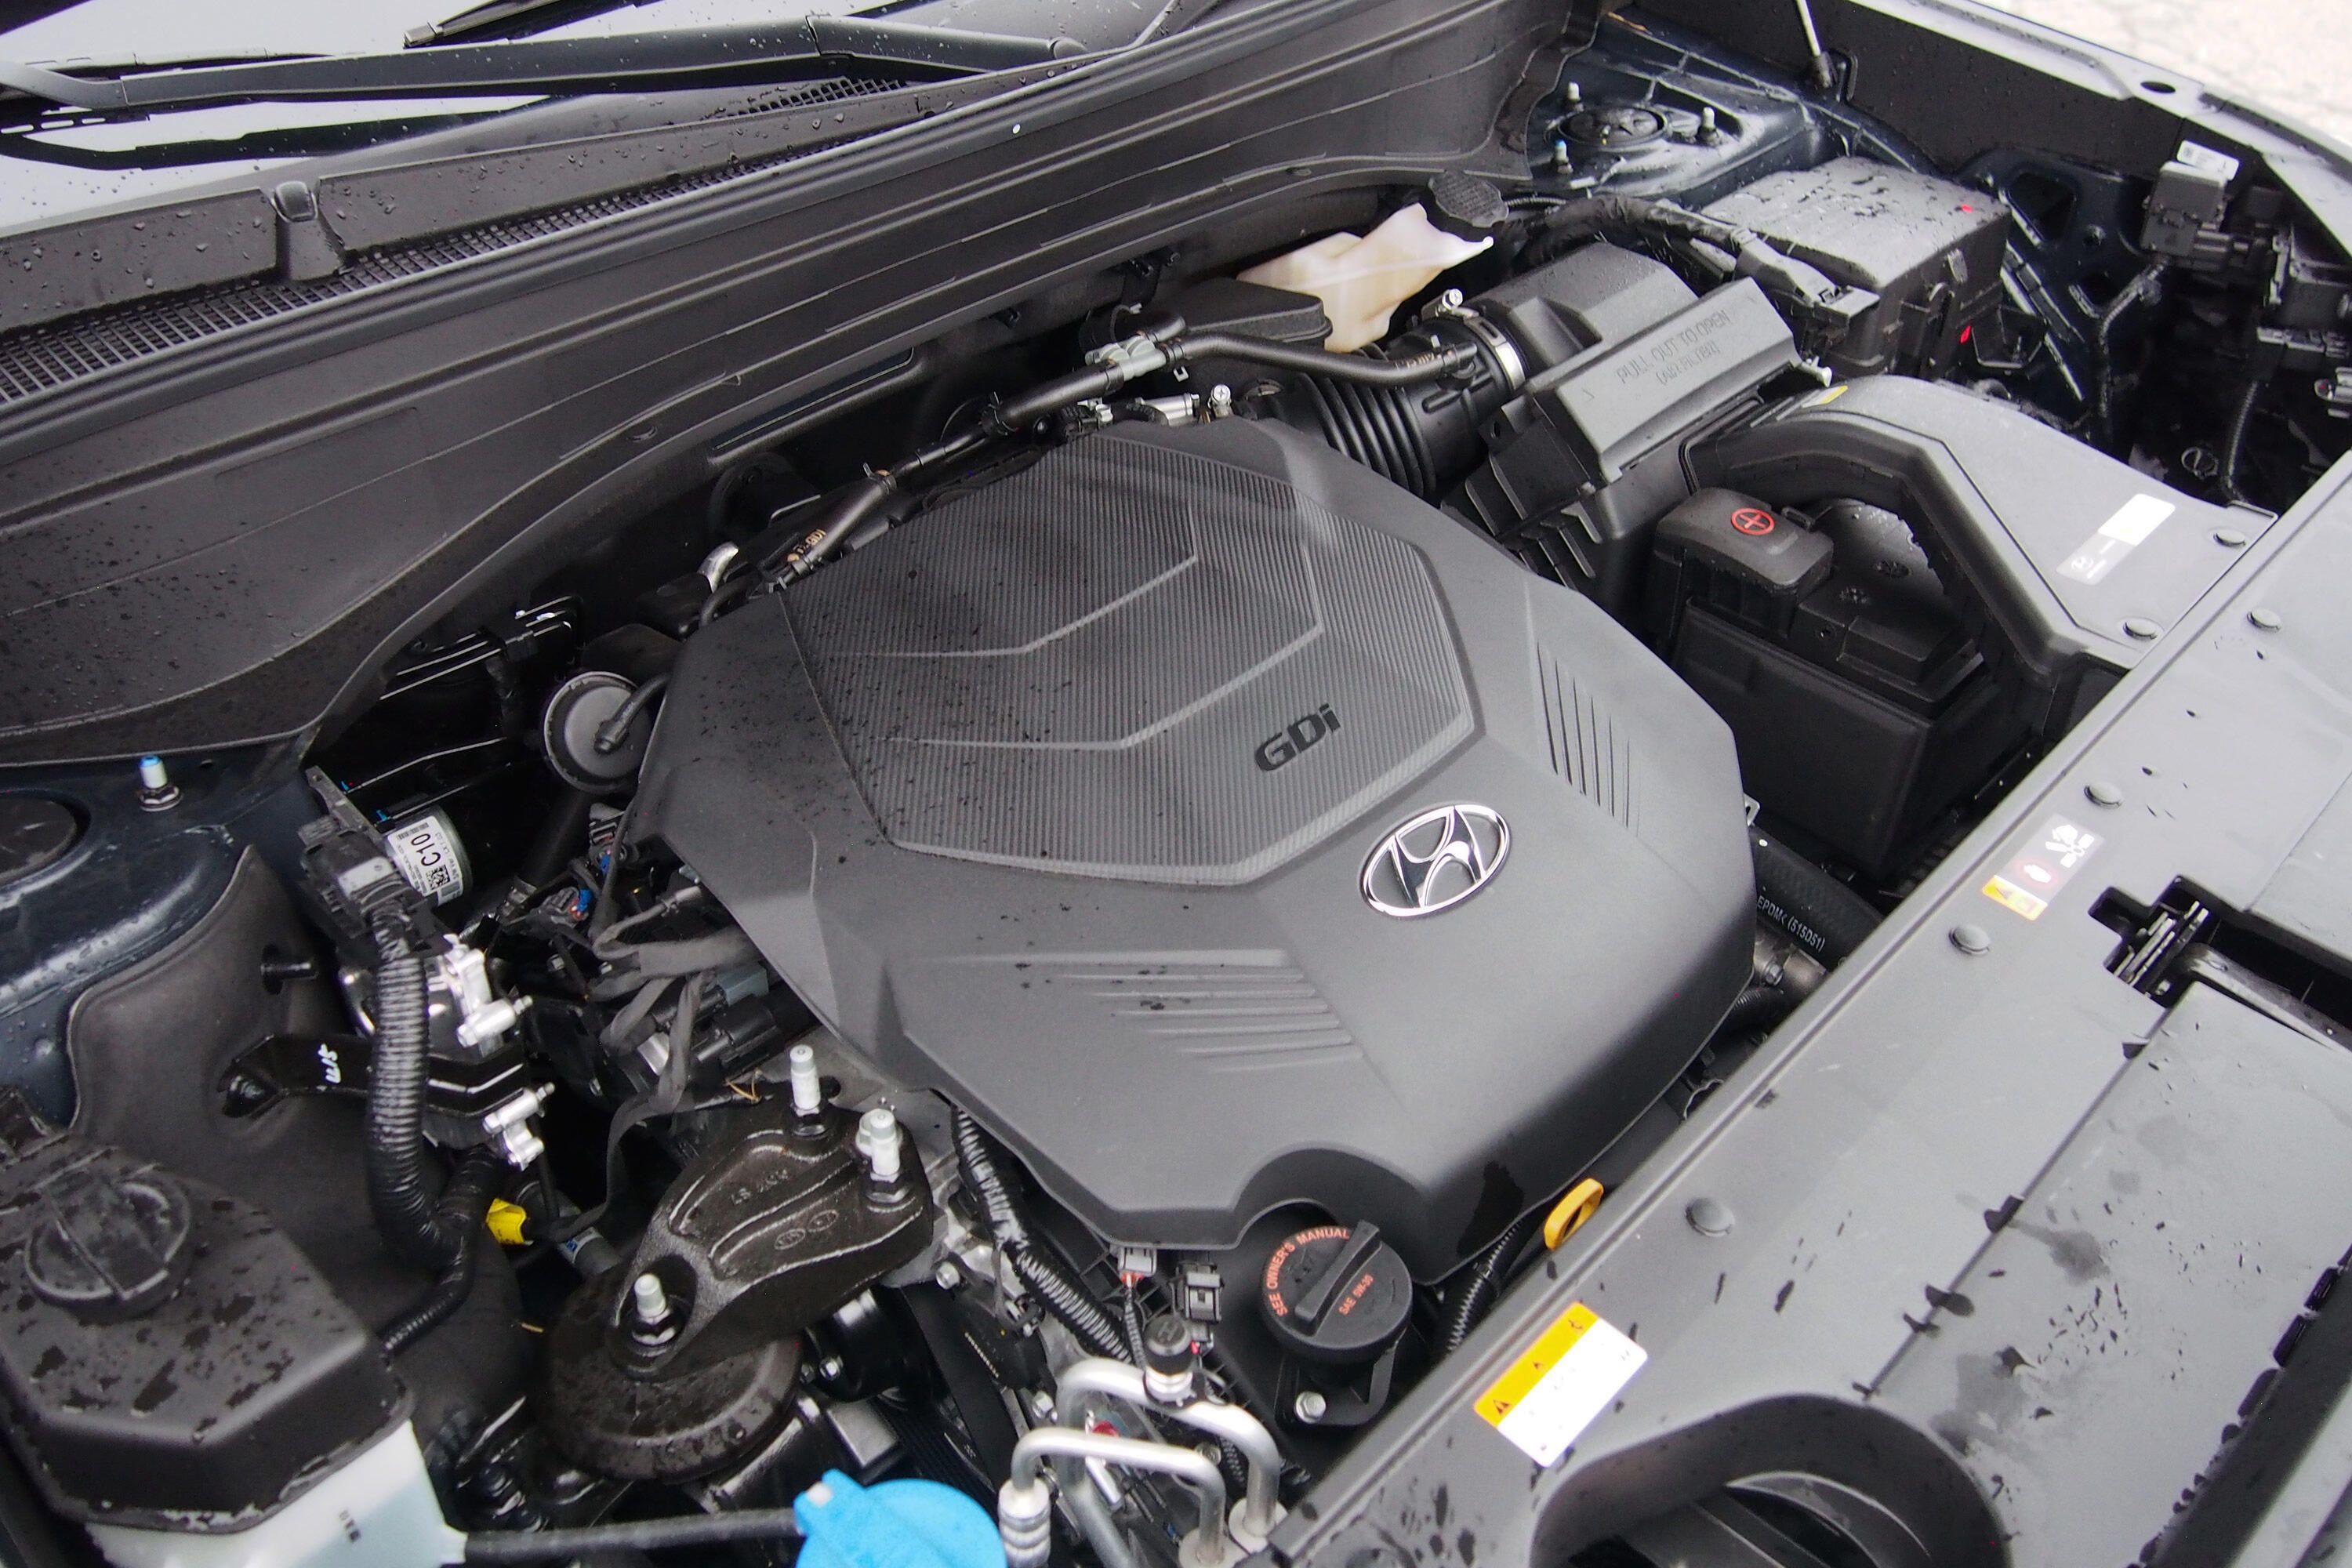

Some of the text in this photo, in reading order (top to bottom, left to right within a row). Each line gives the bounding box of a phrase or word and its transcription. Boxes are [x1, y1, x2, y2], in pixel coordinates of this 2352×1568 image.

[1616, 309, 1731, 383] PULL OUT TO OPEN
[1254, 702, 1341, 771] GDi
[411, 833, 441, 867] C10
[1266, 1228, 1350, 1318] SEE OWNER'S MANUAL
[1338, 1297, 1358, 1316] SAE
